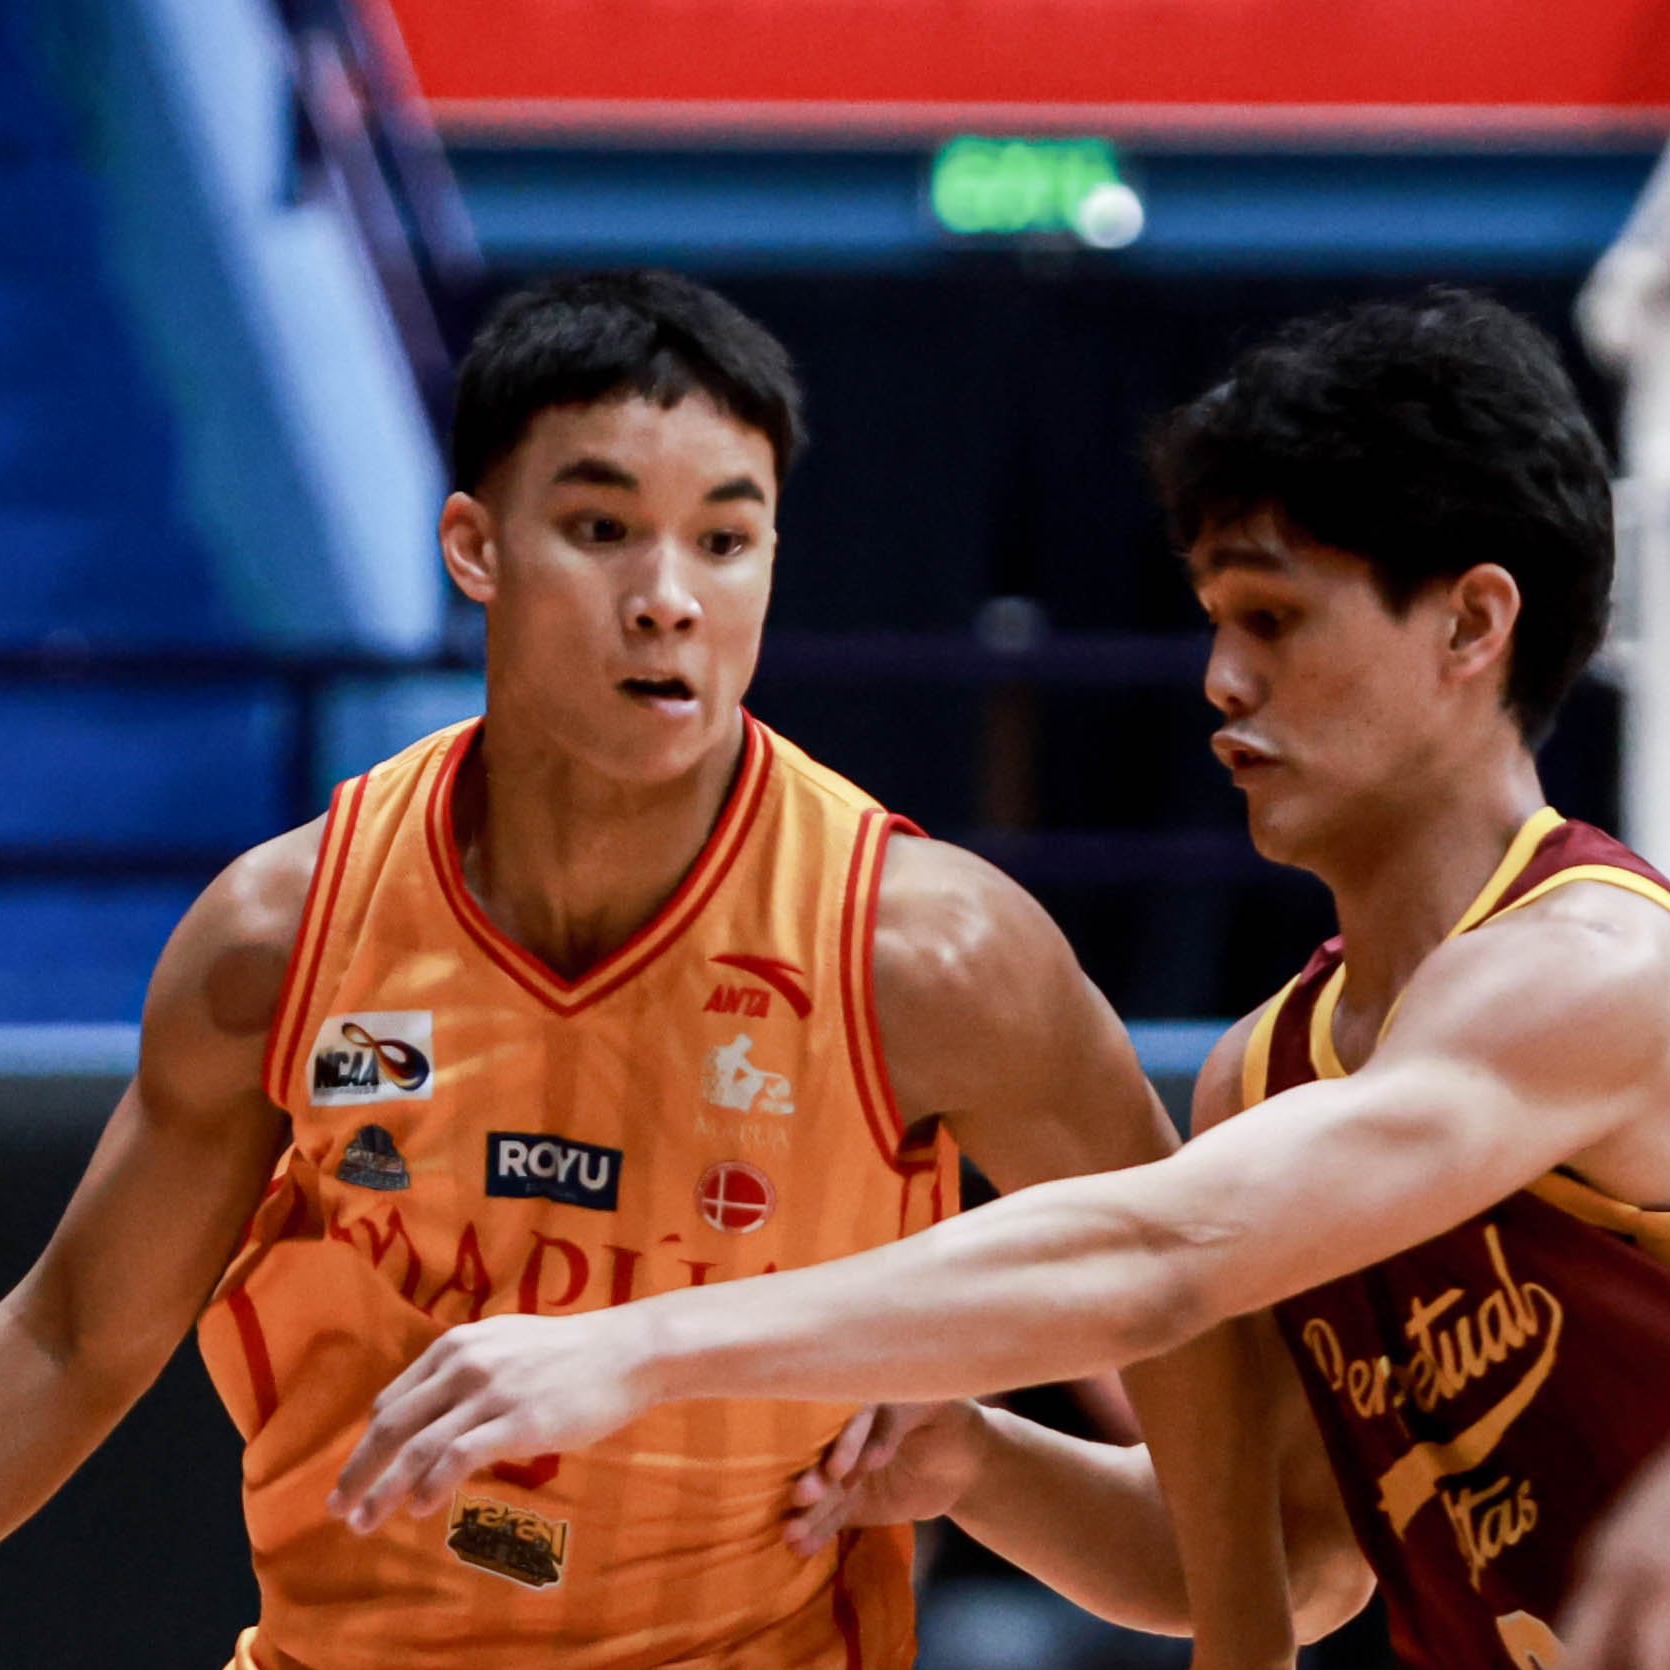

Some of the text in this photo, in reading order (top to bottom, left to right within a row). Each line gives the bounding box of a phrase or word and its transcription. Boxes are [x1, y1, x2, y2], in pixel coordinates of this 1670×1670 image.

[703, 984, 771, 1018] ANTA
[313, 1050, 379, 1089] NCAA
[498, 1140, 610, 1190] ROYU
[329, 1205, 779, 1323] MAP
[1303, 1224, 1562, 1420] Peretual
